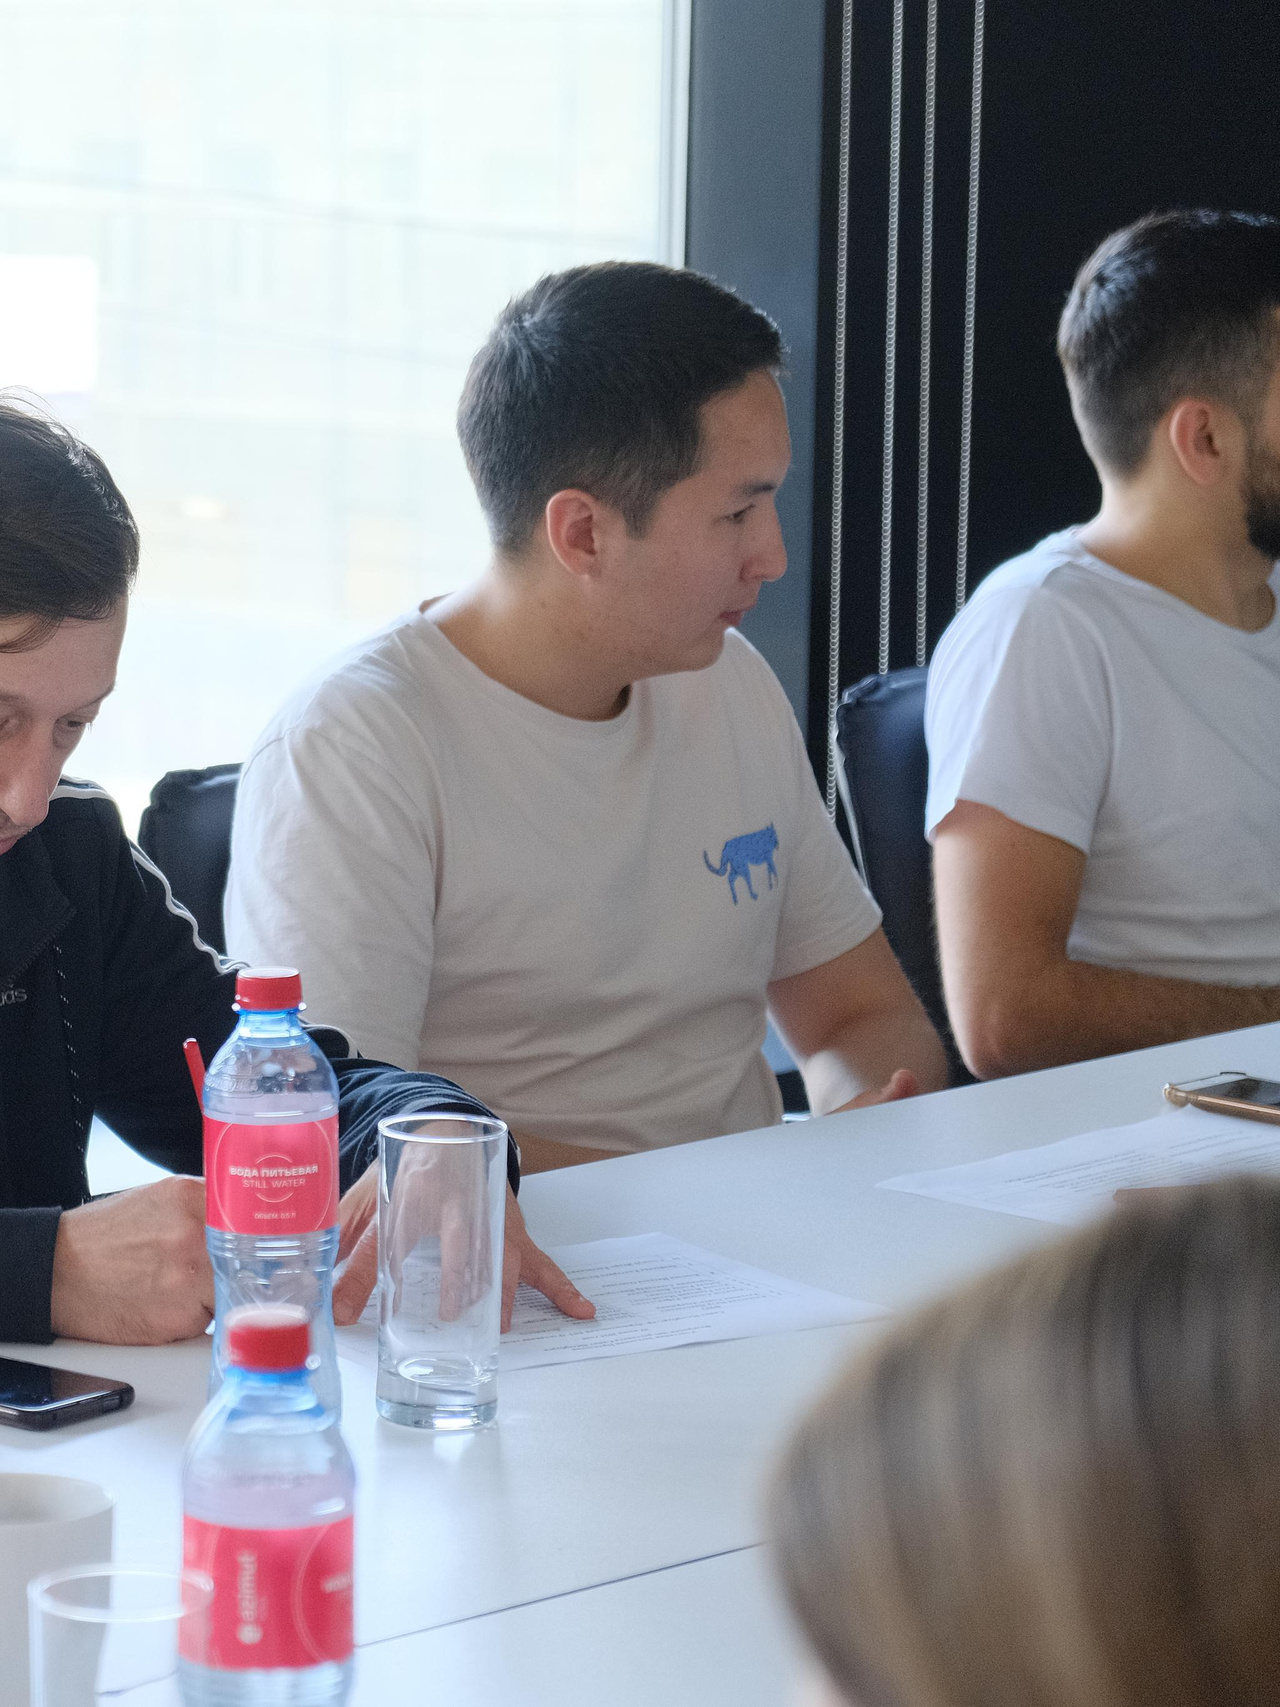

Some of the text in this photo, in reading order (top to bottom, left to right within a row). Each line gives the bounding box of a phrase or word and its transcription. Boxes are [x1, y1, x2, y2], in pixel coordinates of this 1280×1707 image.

[229, 1165, 319, 1178] ВОДА ПИТЬЕВАЯ
[242, 1178, 306, 1189] STILL WATER
